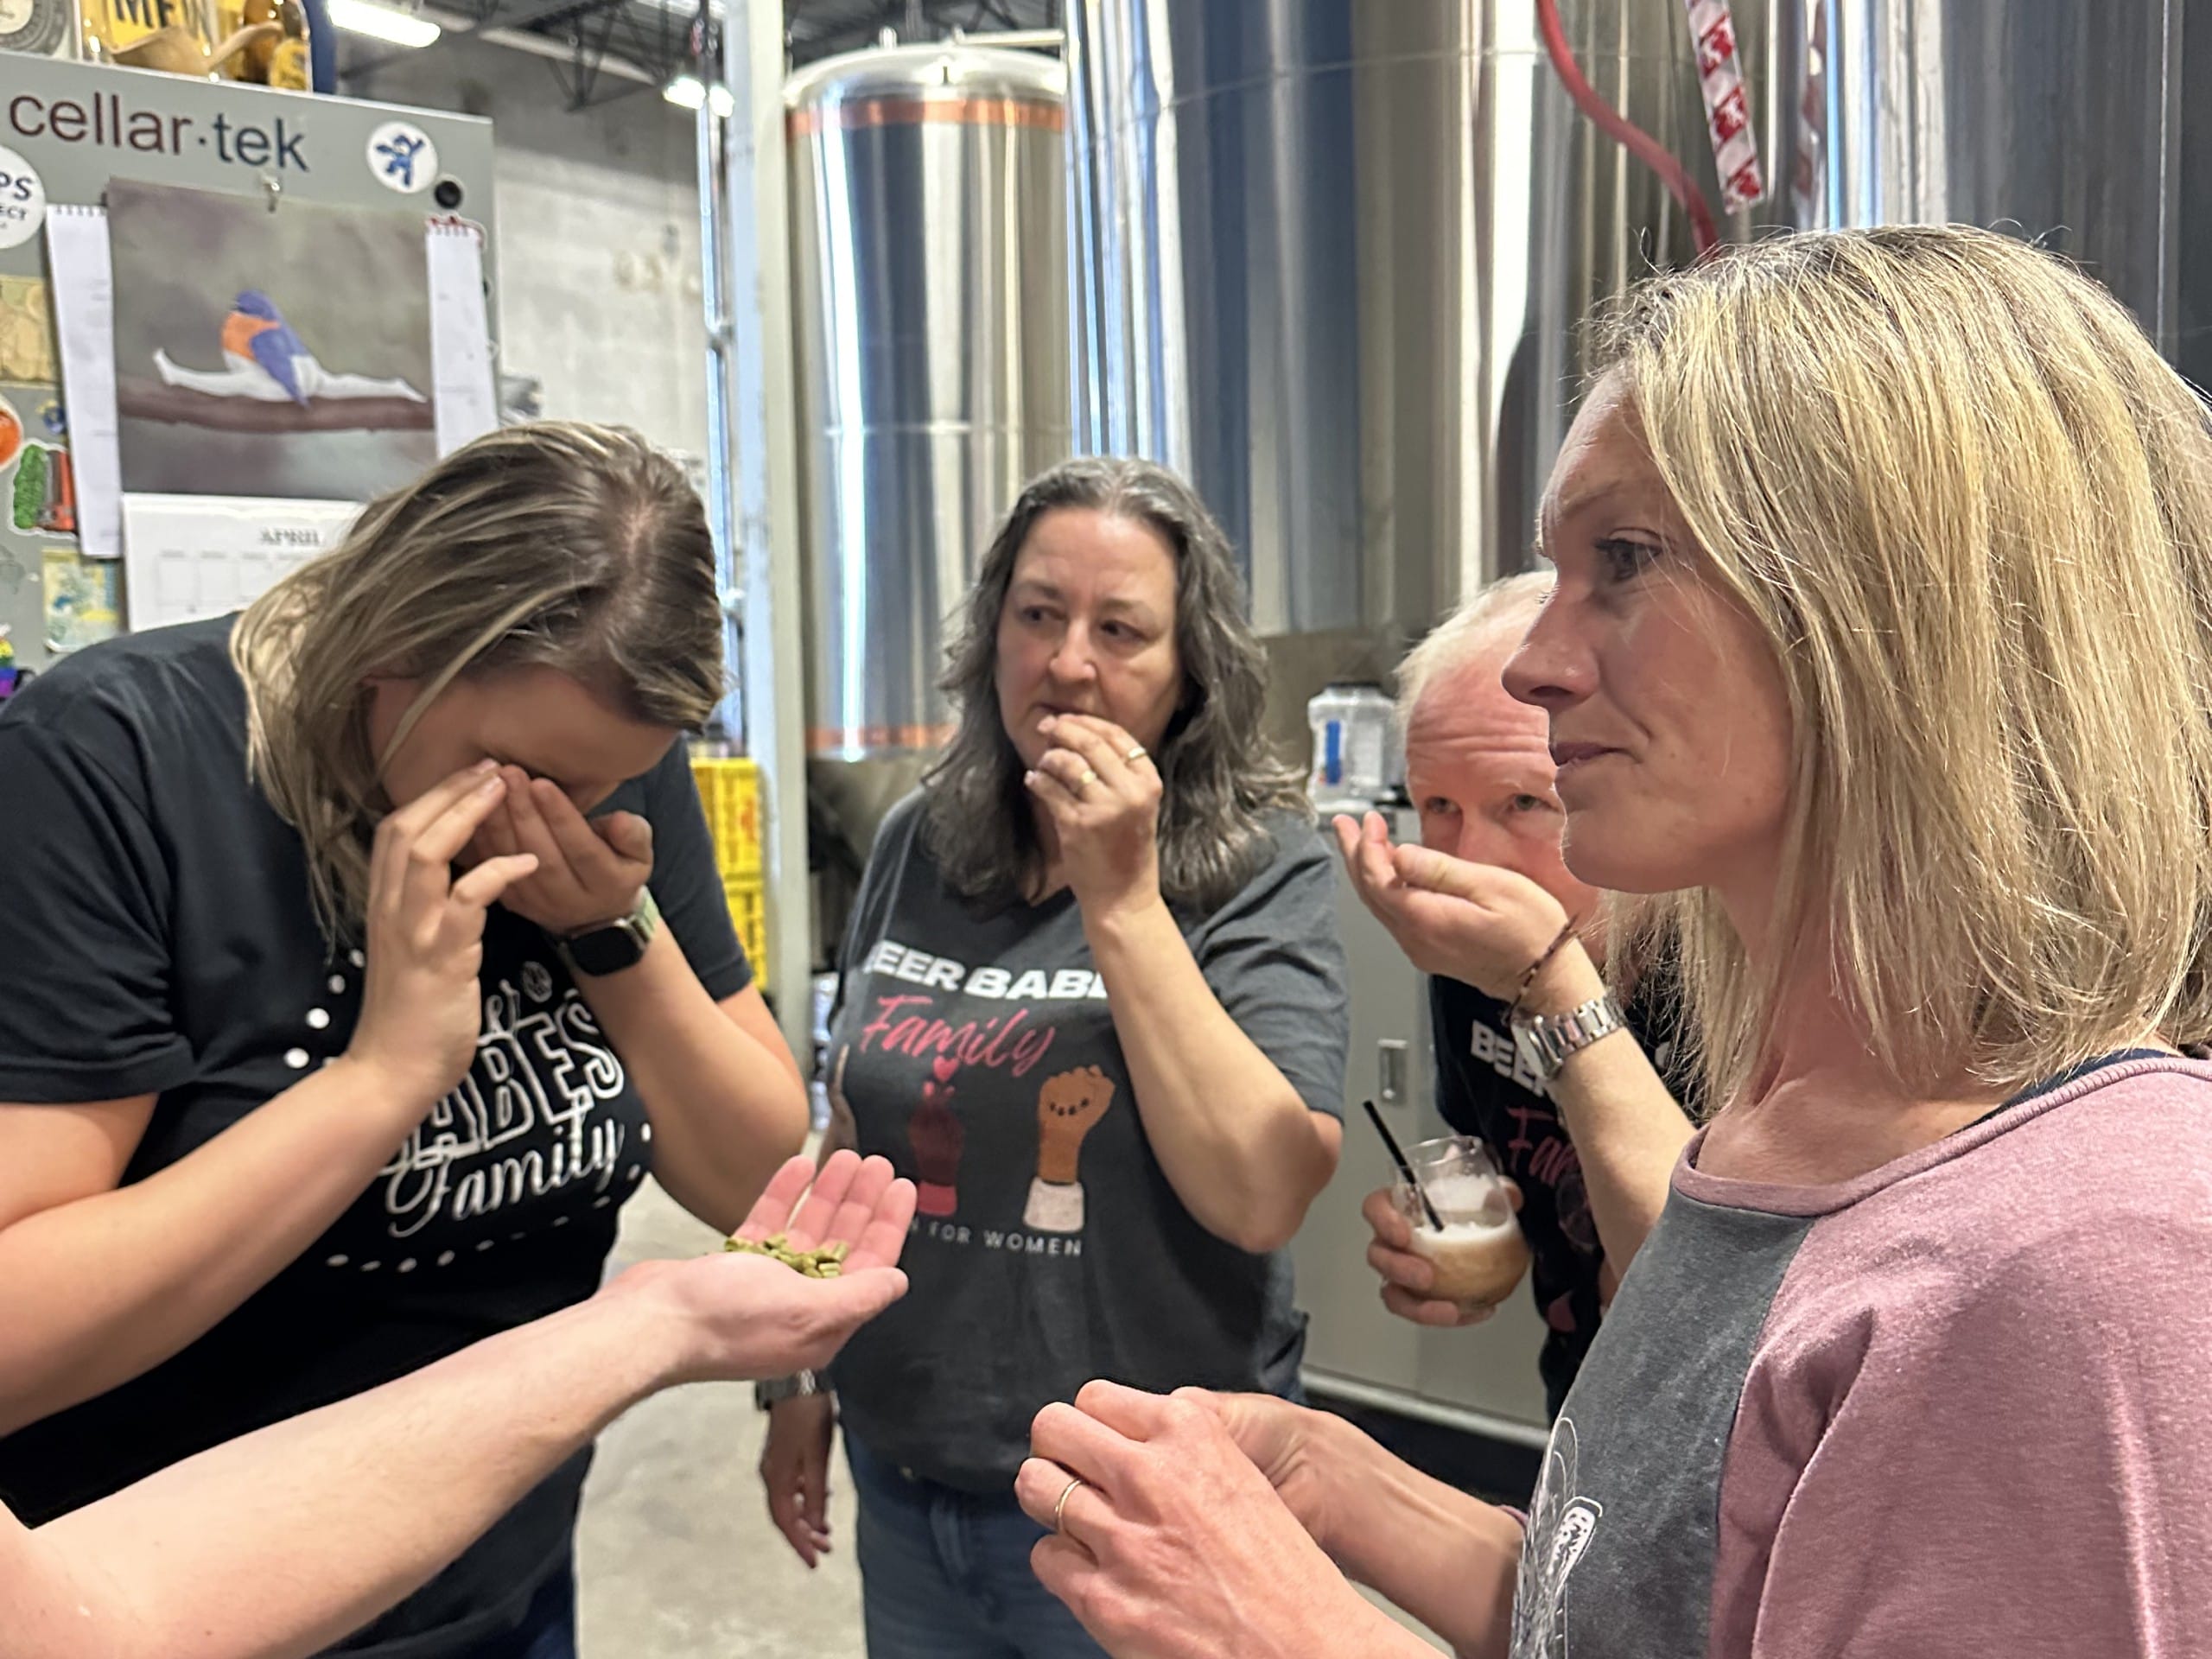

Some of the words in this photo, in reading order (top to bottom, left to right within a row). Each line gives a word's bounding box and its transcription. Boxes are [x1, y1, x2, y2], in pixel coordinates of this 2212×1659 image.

[863, 939, 965, 991] EER
[859, 995, 1056, 1077] Family
[385, 1116, 626, 1237] Family
[928, 1221, 971, 1244] FOR
[983, 1229, 1083, 1256] WOMEN
